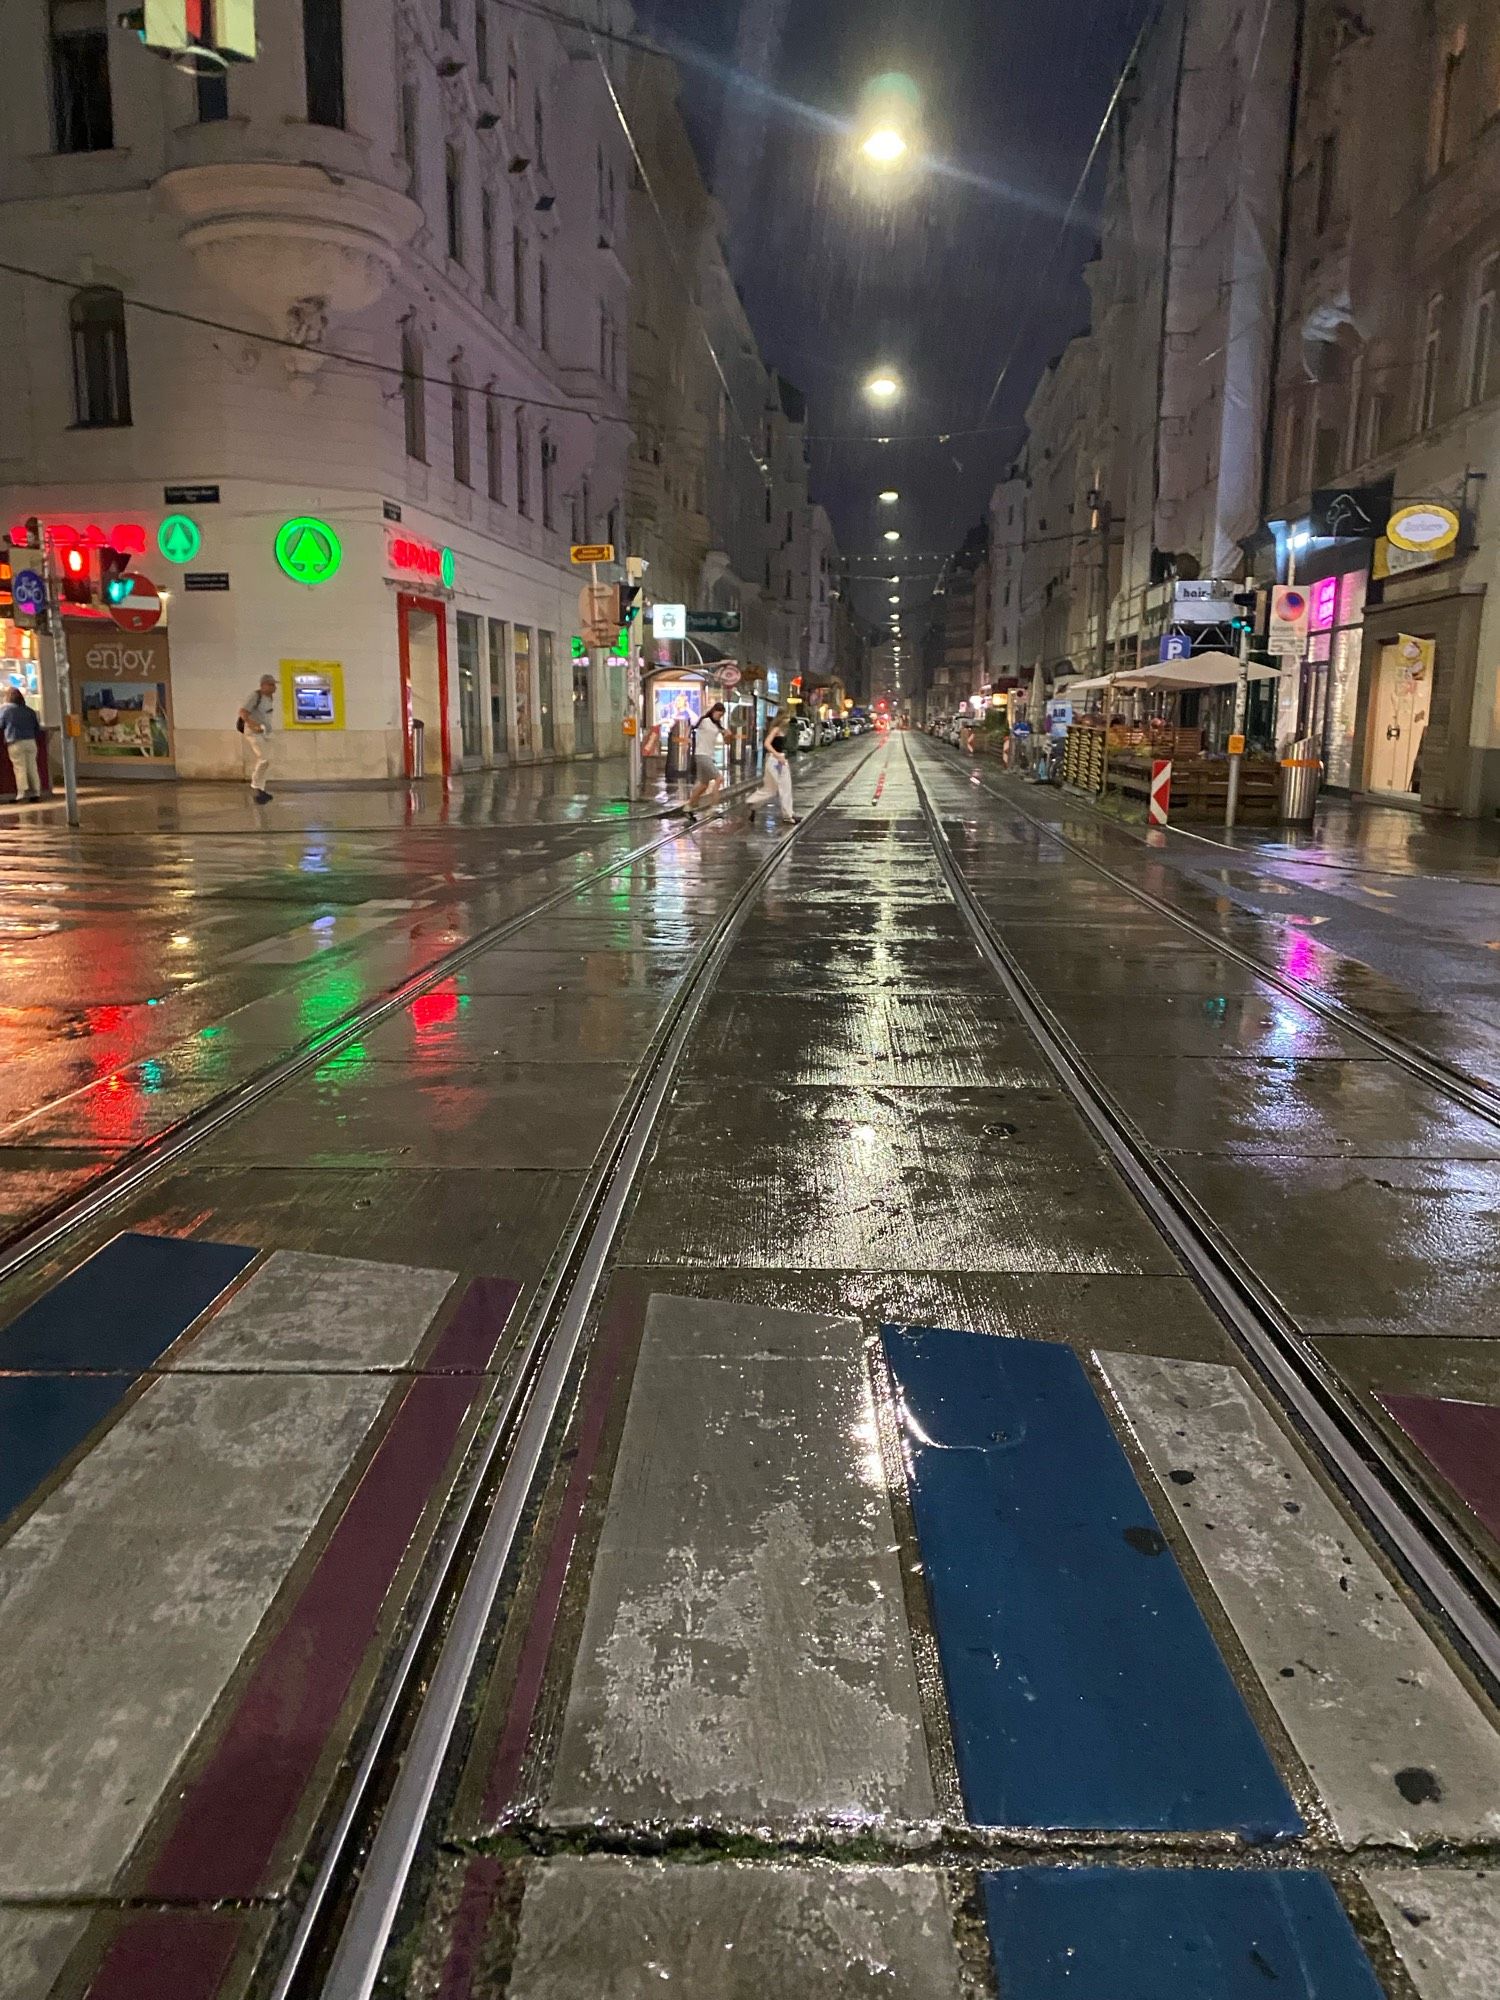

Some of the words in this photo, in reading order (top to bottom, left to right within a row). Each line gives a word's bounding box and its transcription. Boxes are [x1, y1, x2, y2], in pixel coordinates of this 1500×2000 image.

[394, 538, 440, 576] SPAR
[1183, 587, 1233, 598] hair-ir
[86, 646, 156, 676] enjoy.
[1167, 641, 1182, 659] P
